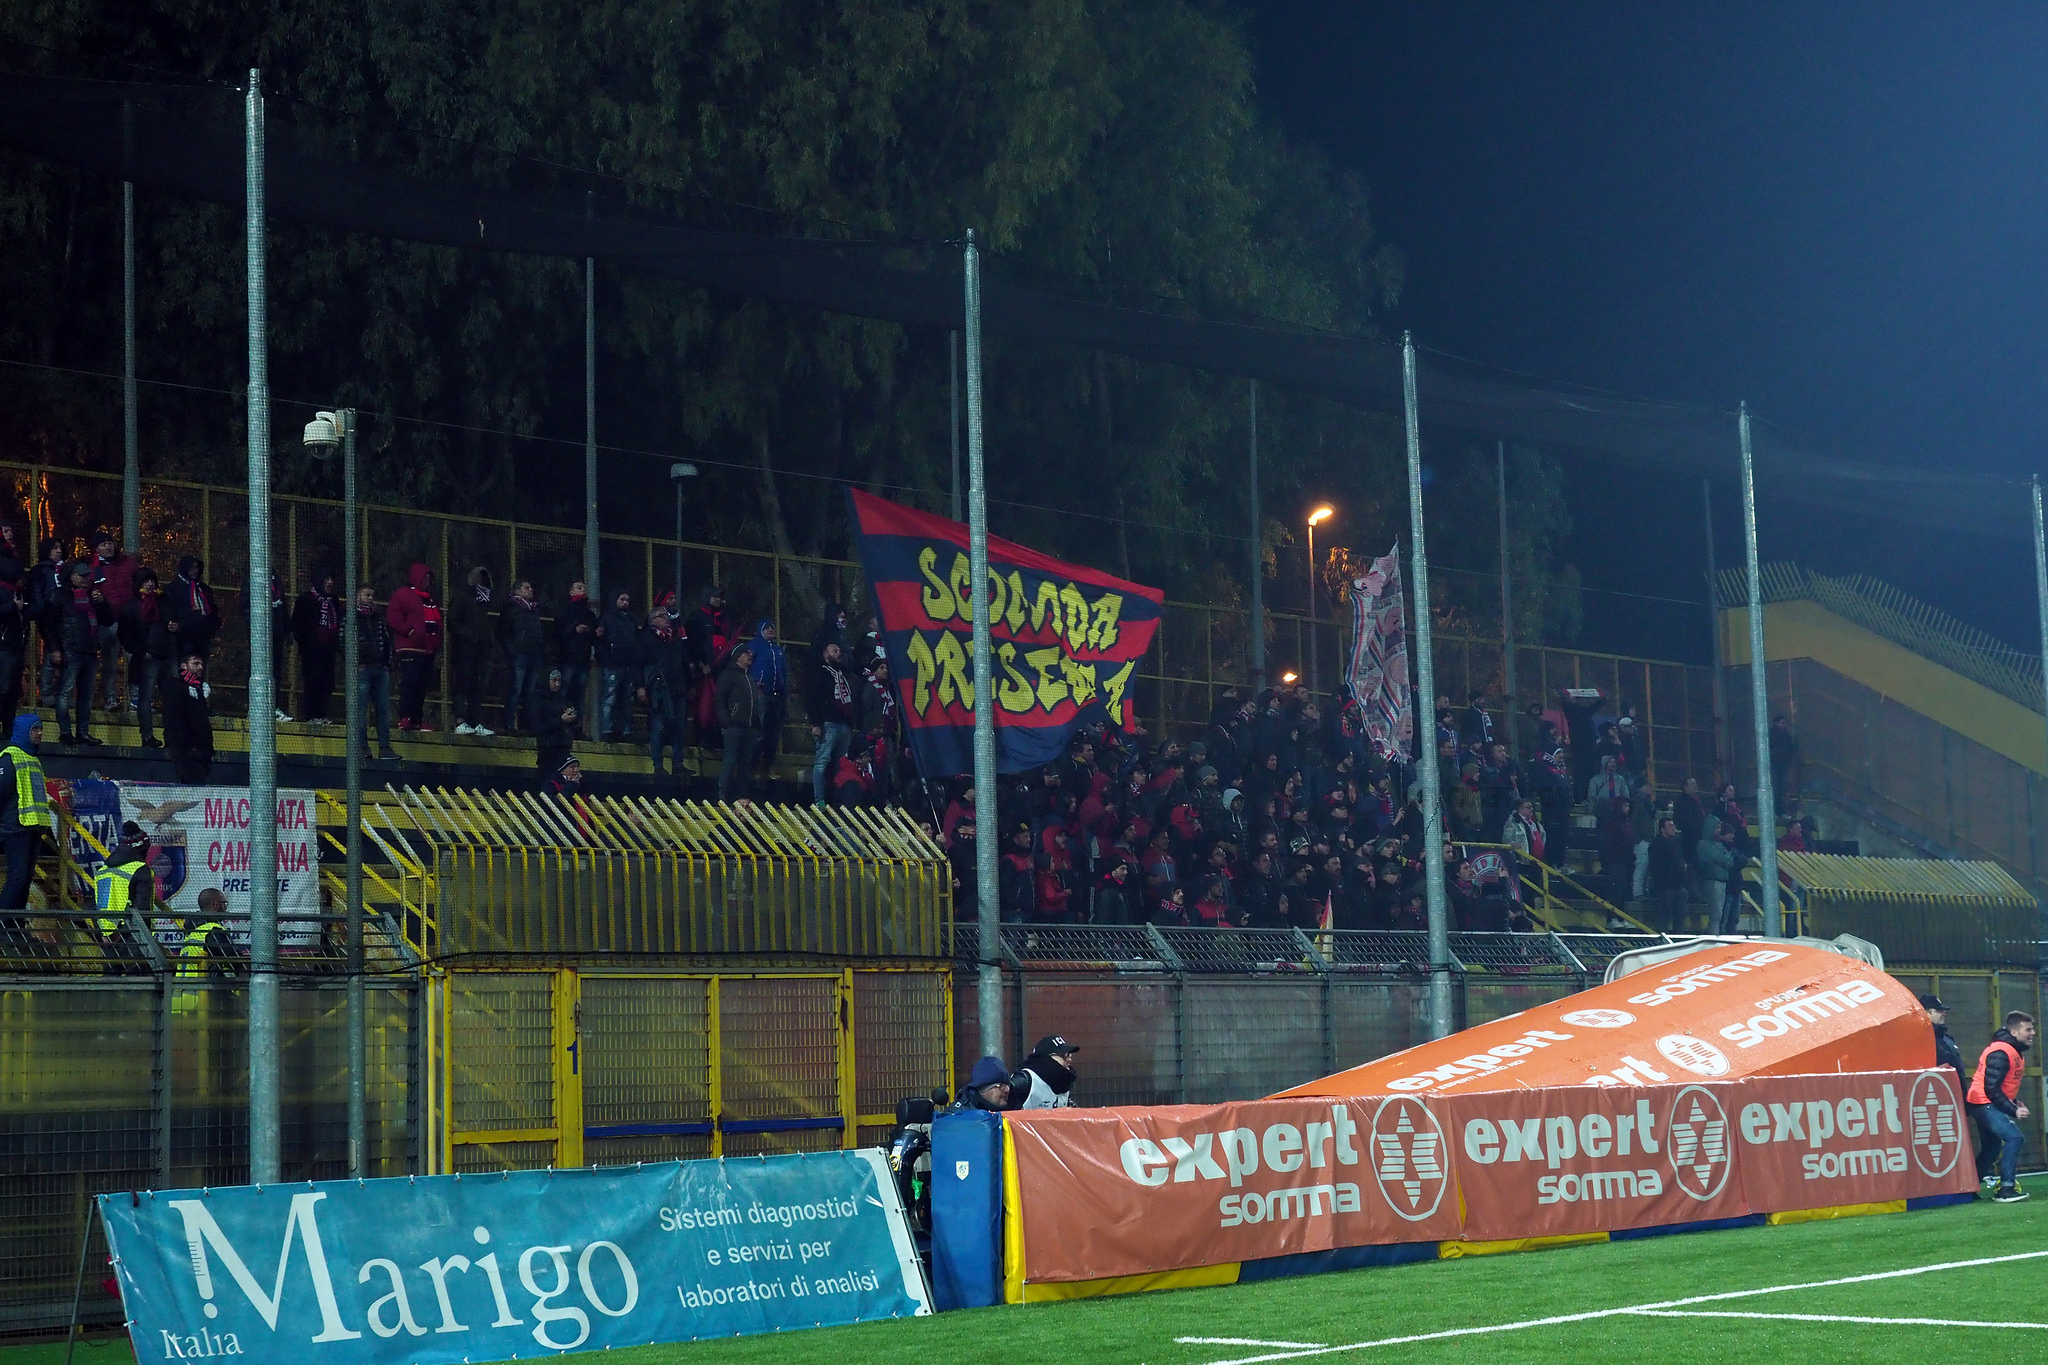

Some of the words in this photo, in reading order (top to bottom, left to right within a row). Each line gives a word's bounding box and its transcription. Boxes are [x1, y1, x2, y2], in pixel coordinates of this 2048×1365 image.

[204, 798, 308, 830] MACATA
[207, 840, 309, 873] CAMNIA
[222, 878, 290, 892] PREE
[1627, 950, 1792, 1007] somma
[1719, 979, 1886, 1049] somma
[1754, 986, 1807, 1010] gruppo
[1386, 1030, 1575, 1091] expert
[1464, 1099, 1659, 1169] expert
[1740, 1083, 1903, 1148] expert
[1119, 1104, 1359, 1188] expert
[1802, 1147, 1908, 1181] somma
[1219, 1181, 1361, 1228] somma
[1537, 1168, 1663, 1205] somma
[659, 1203, 743, 1232] Sistemi
[747, 1196, 859, 1228] diagnostici
[168, 1191, 640, 1351] Marigo
[707, 1248, 721, 1266] e
[728, 1239, 793, 1264] servizi
[799, 1240, 832, 1264] per
[677, 1279, 786, 1309] laboratori
[790, 1275, 811, 1297] di
[815, 1269, 880, 1296] analisi
[159, 1326, 244, 1360] Italia
